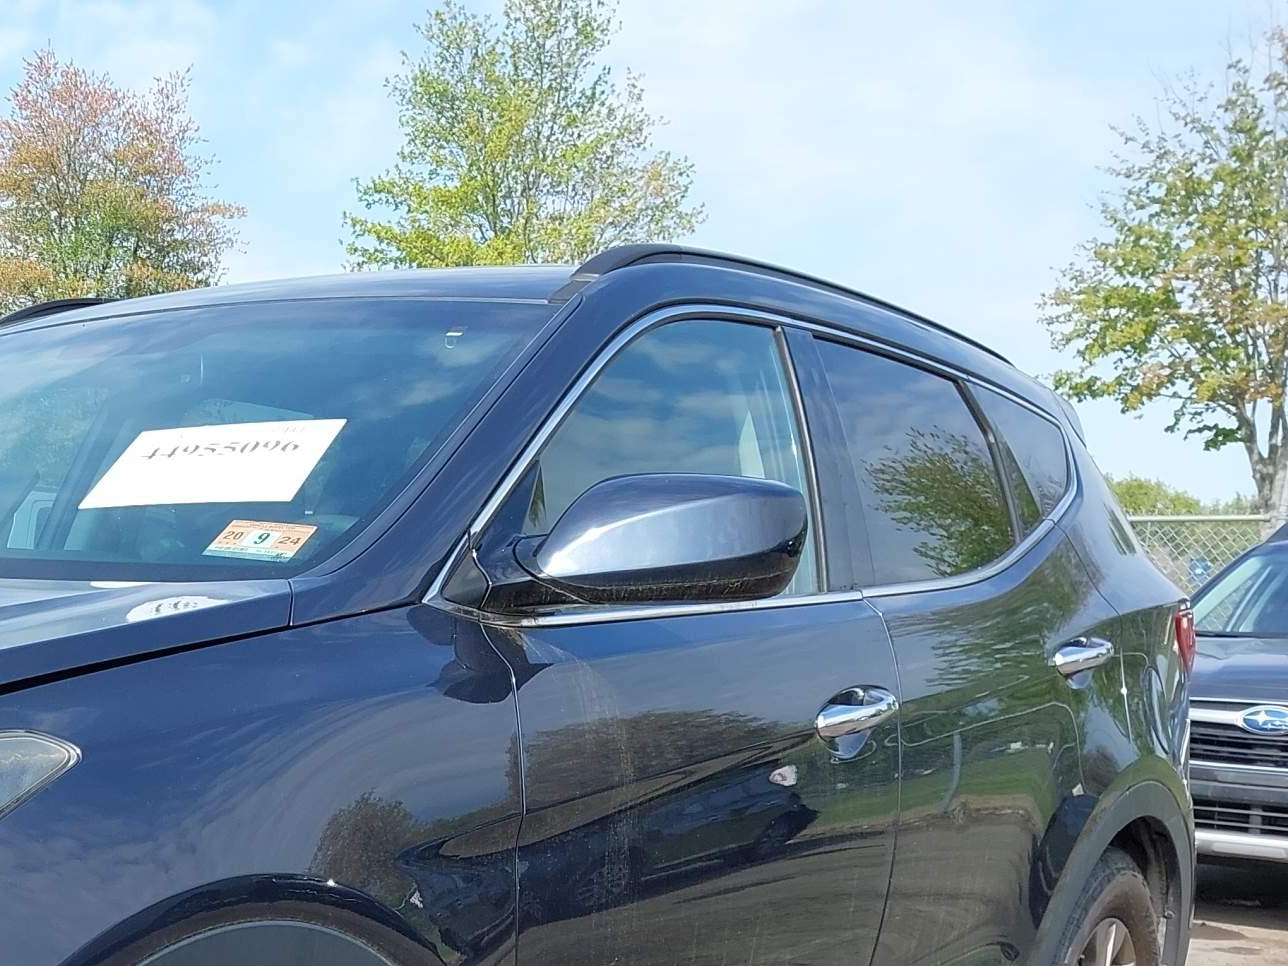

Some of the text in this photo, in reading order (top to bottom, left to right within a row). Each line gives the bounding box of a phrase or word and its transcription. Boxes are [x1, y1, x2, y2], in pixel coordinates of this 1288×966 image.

[222, 530, 302, 546] 20 9 24
